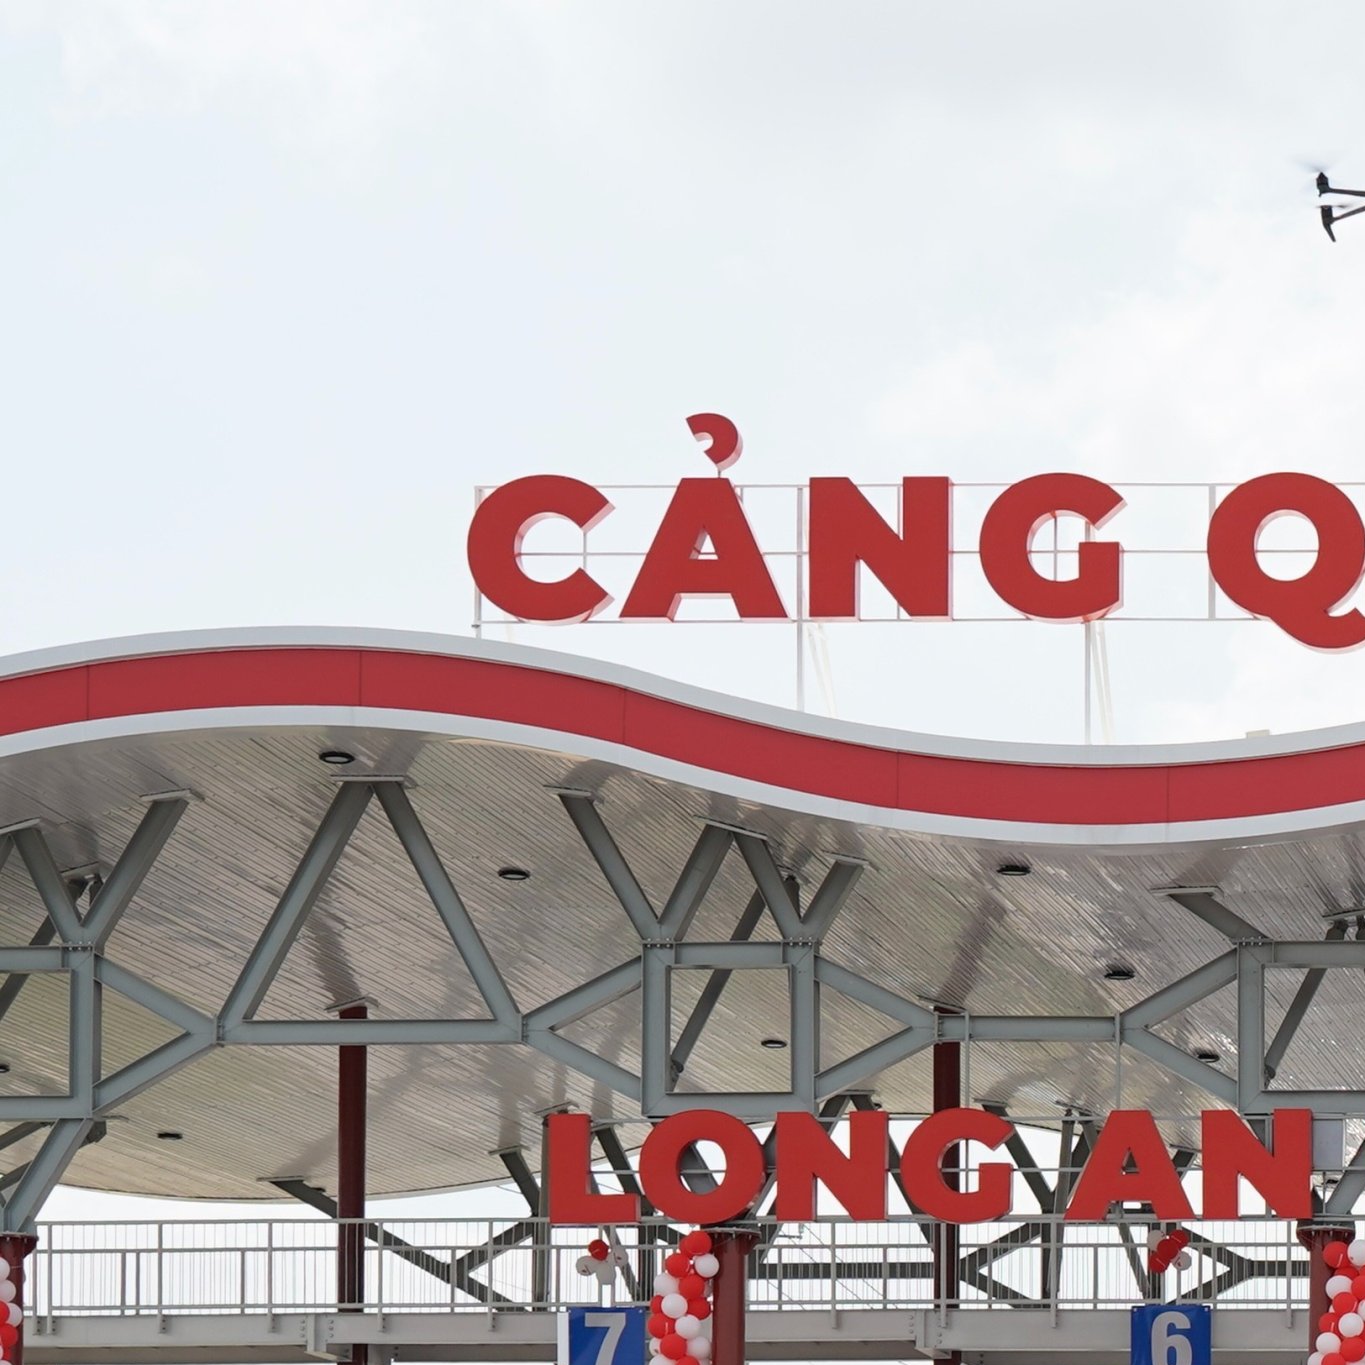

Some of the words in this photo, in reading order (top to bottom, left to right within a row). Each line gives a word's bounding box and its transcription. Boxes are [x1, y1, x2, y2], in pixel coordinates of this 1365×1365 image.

[467, 413, 1124, 624] CẢNG
[547, 1107, 1015, 1227] LONG
[1064, 1107, 1314, 1223] AN
